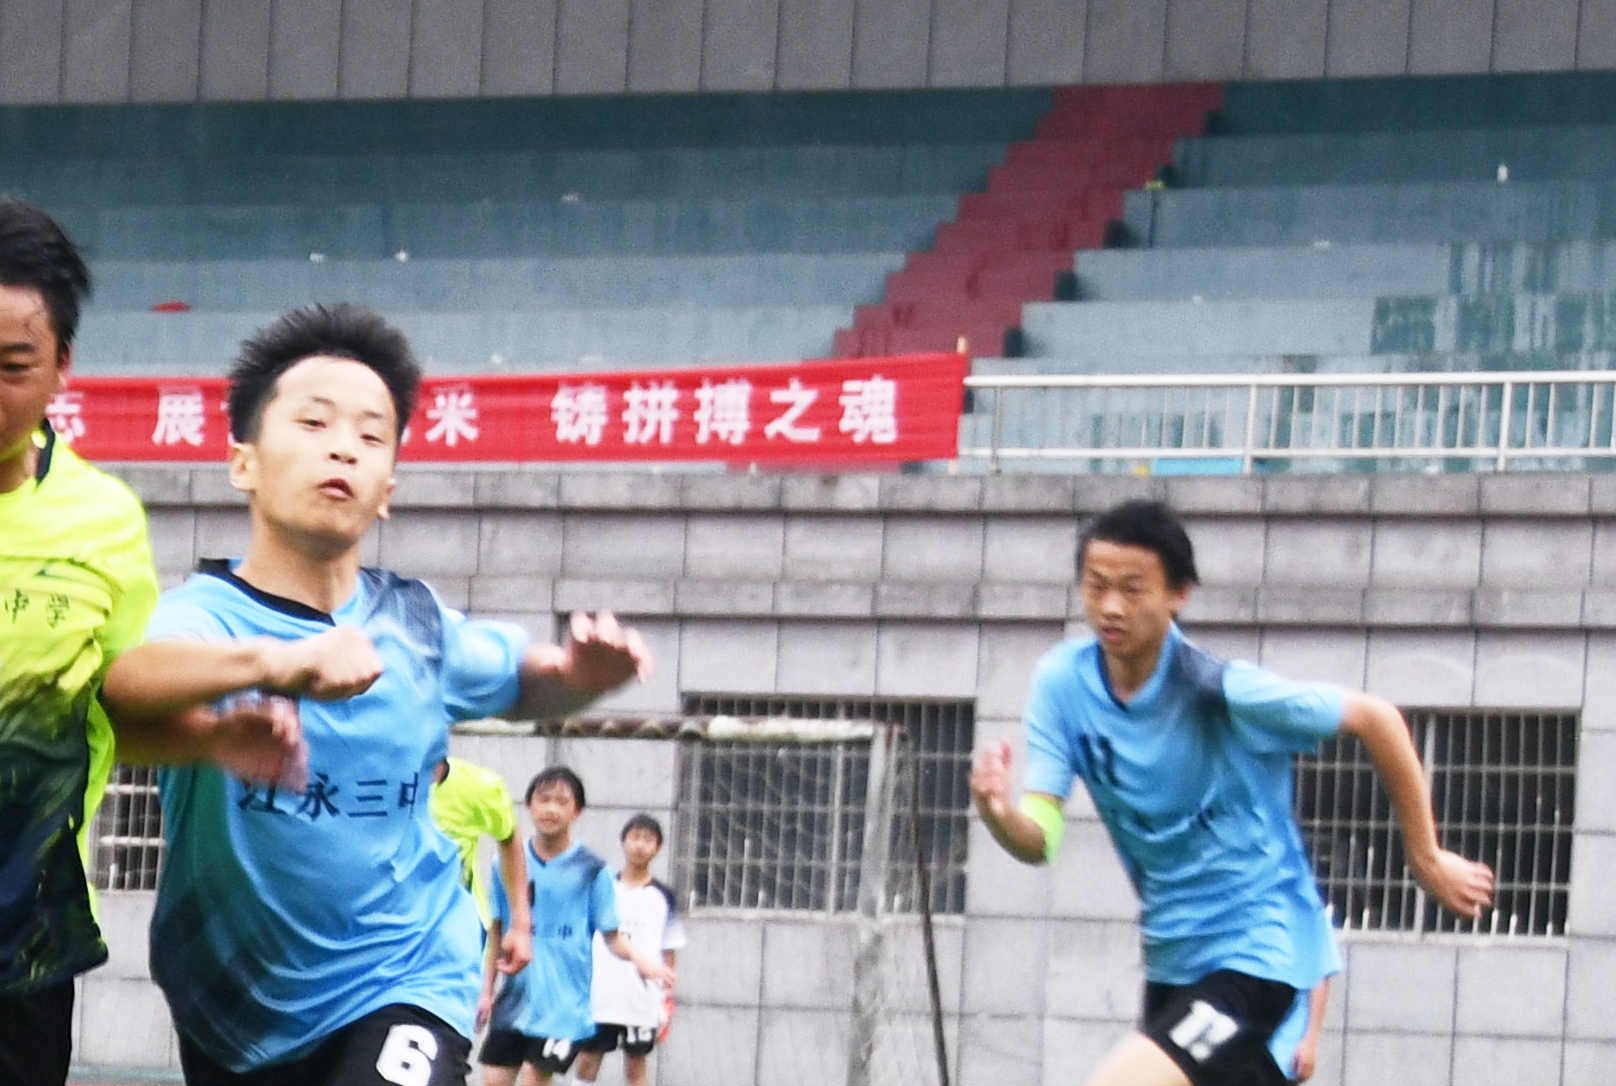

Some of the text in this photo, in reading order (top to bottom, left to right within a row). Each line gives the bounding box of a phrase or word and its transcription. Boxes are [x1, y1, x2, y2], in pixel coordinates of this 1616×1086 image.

[551, 375, 898, 446] 铸拼搏之魂
